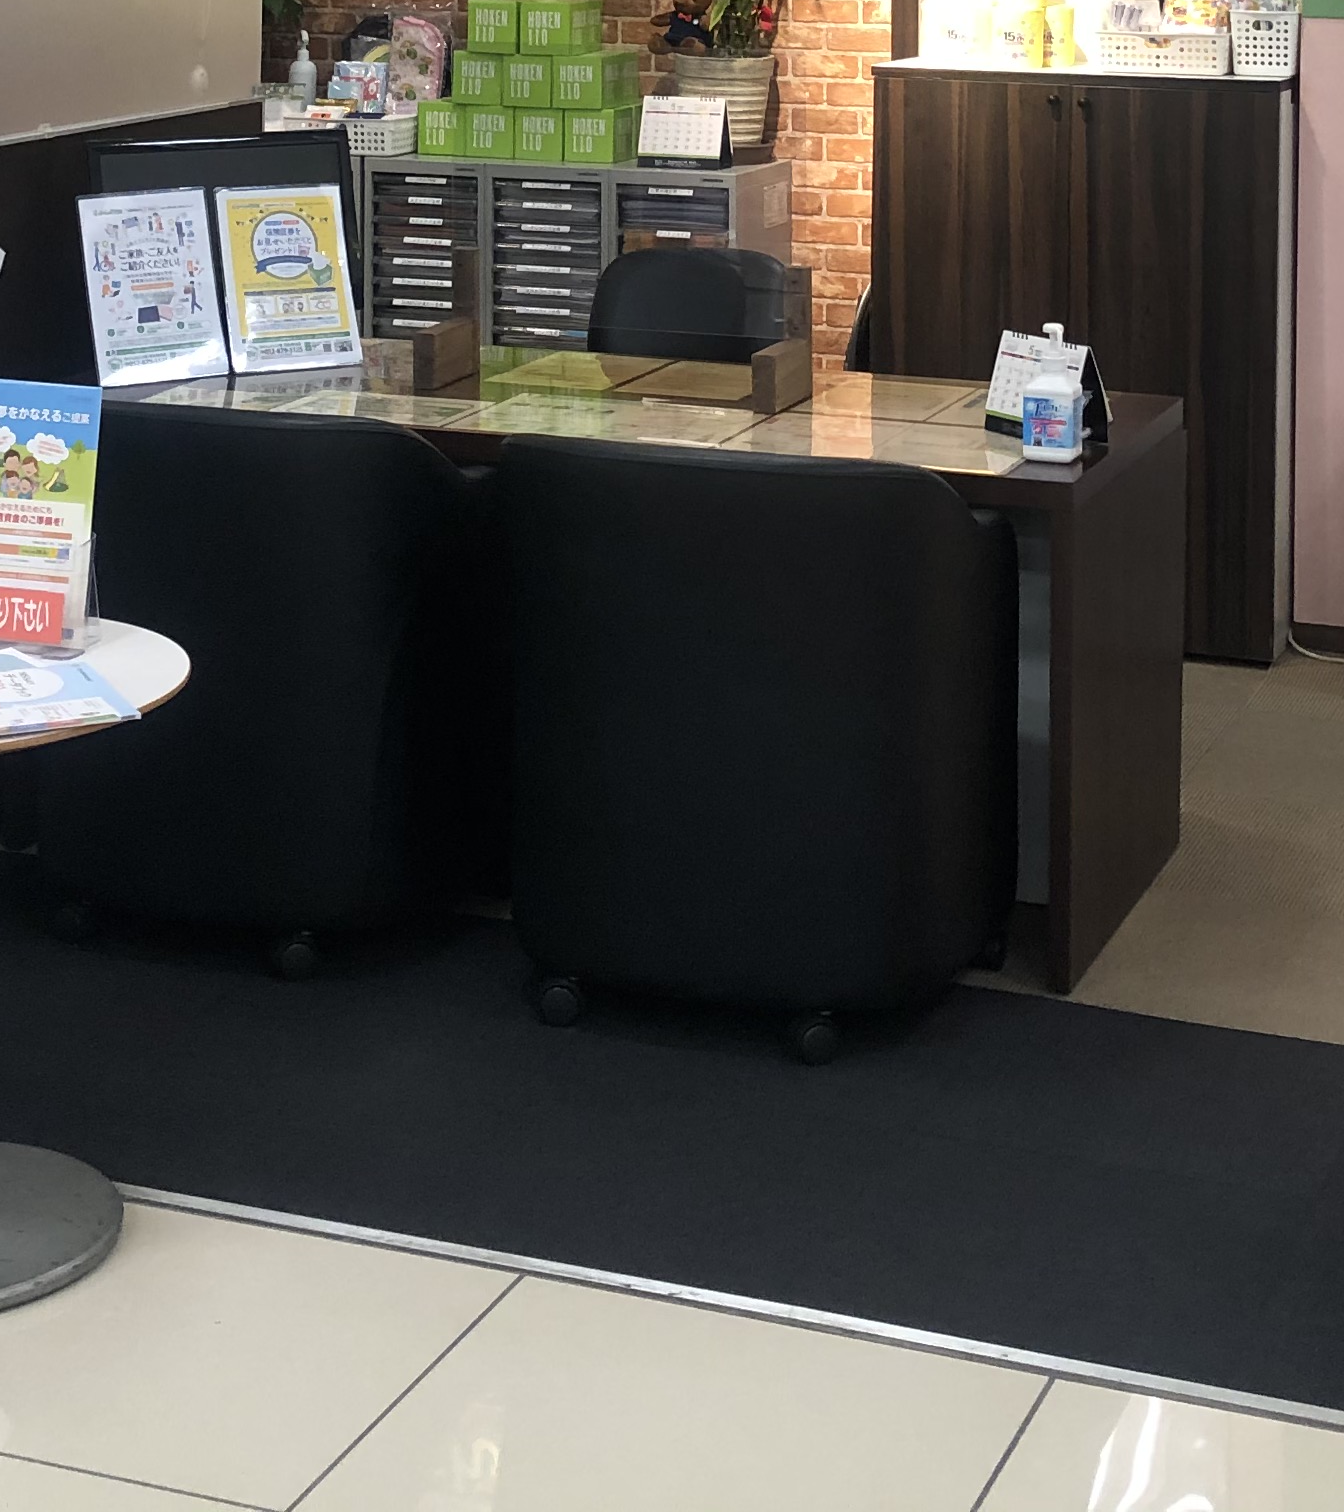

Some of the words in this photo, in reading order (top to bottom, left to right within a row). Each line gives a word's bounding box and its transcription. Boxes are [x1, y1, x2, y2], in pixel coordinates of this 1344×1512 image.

[475, 7, 509, 27] HOKEN
[527, 10, 561, 29] HOKEN
[475, 26, 495, 43] 110
[528, 29, 548, 46] 110
[461, 60, 496, 79] HOKEN
[509, 63, 543, 81] HOKEN
[559, 64, 593, 83] HOKEN
[460, 77, 481, 96] 110
[510, 81, 530, 98] 110
[559, 83, 580, 100] 110
[425, 111, 458, 130] HOKEN
[472, 113, 506, 132] HOKEN
[522, 115, 555, 135] HOKEN
[572, 118, 606, 136] HOKEN
[425, 129, 445, 146] 110
[472, 131, 492, 149] 110
[522, 134, 542, 152] 110
[572, 136, 593, 153] 110
